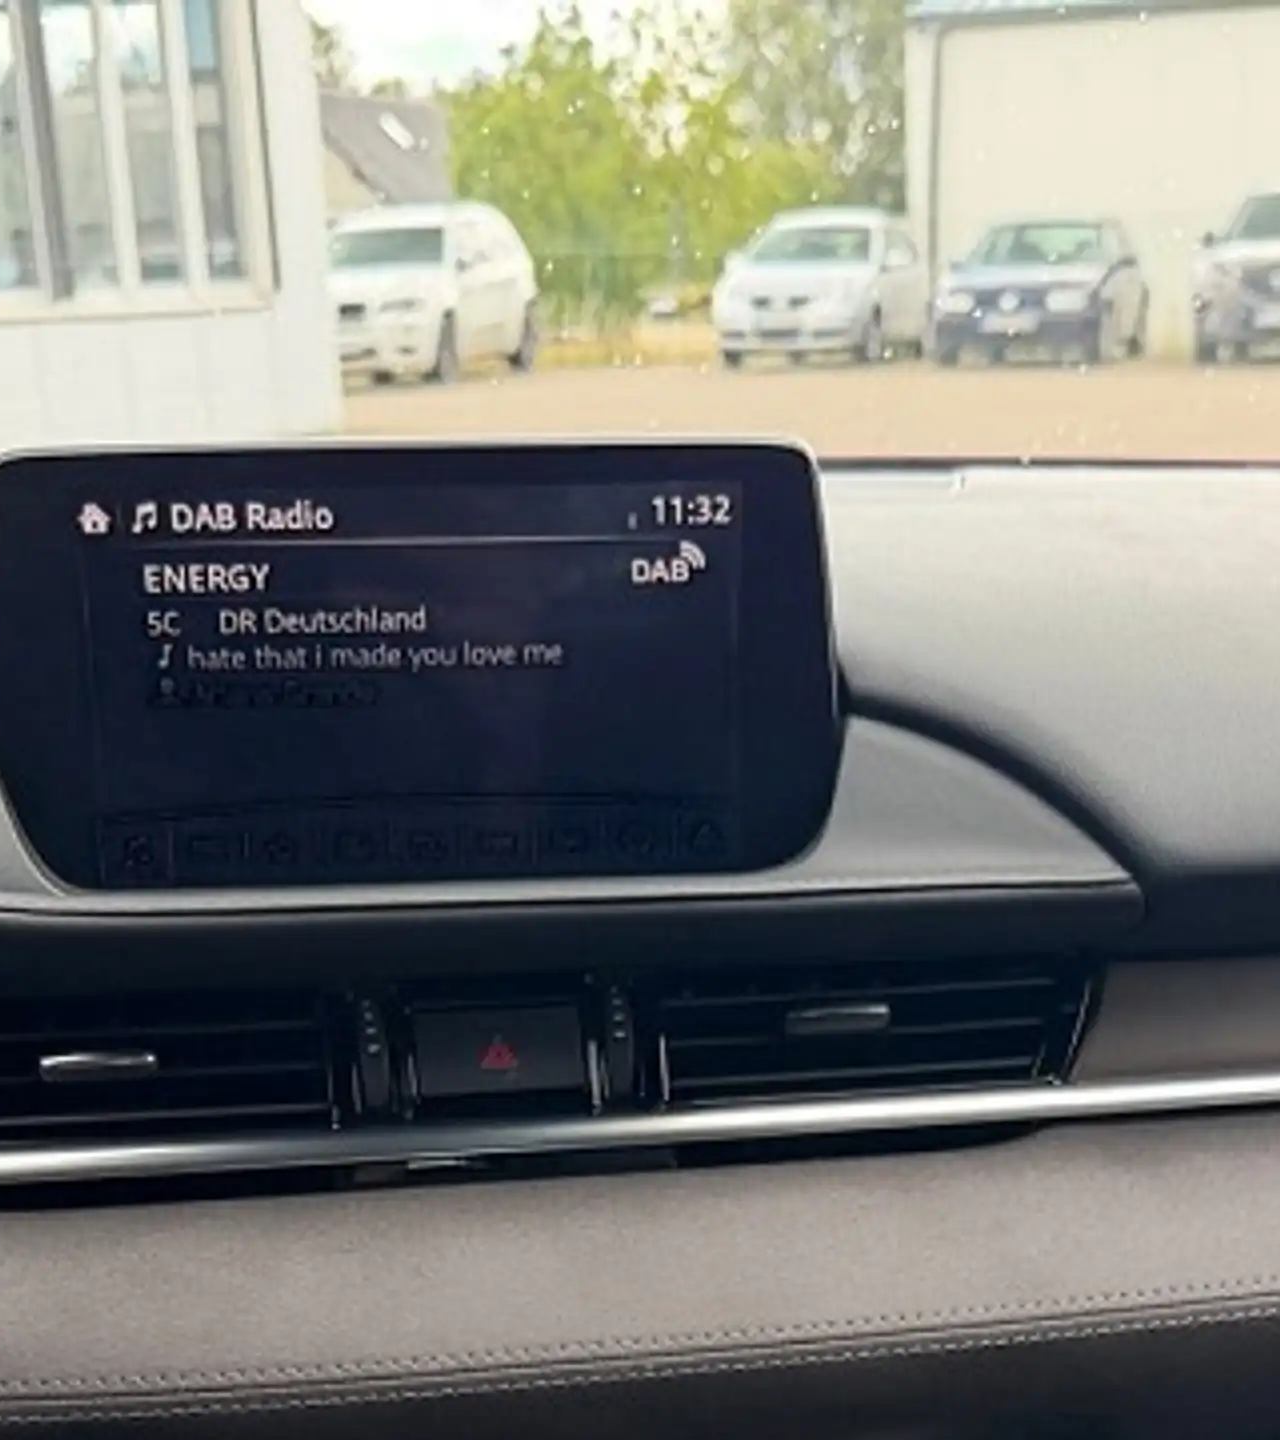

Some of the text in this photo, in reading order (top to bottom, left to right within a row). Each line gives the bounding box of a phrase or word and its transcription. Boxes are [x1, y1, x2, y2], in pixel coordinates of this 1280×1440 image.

[170, 500, 335, 531] DAB Radio
[652, 495, 732, 525] 11:32
[142, 563, 270, 593] ENERGY
[631, 558, 691, 583] DAB
[219, 609, 258, 635] DR
[264, 604, 427, 635] Deutschland
[187, 645, 246, 670] hate
[255, 644, 306, 669] that
[329, 643, 402, 668] made
[407, 644, 458, 672] you
[463, 640, 518, 667] love
[523, 642, 563, 666] me
